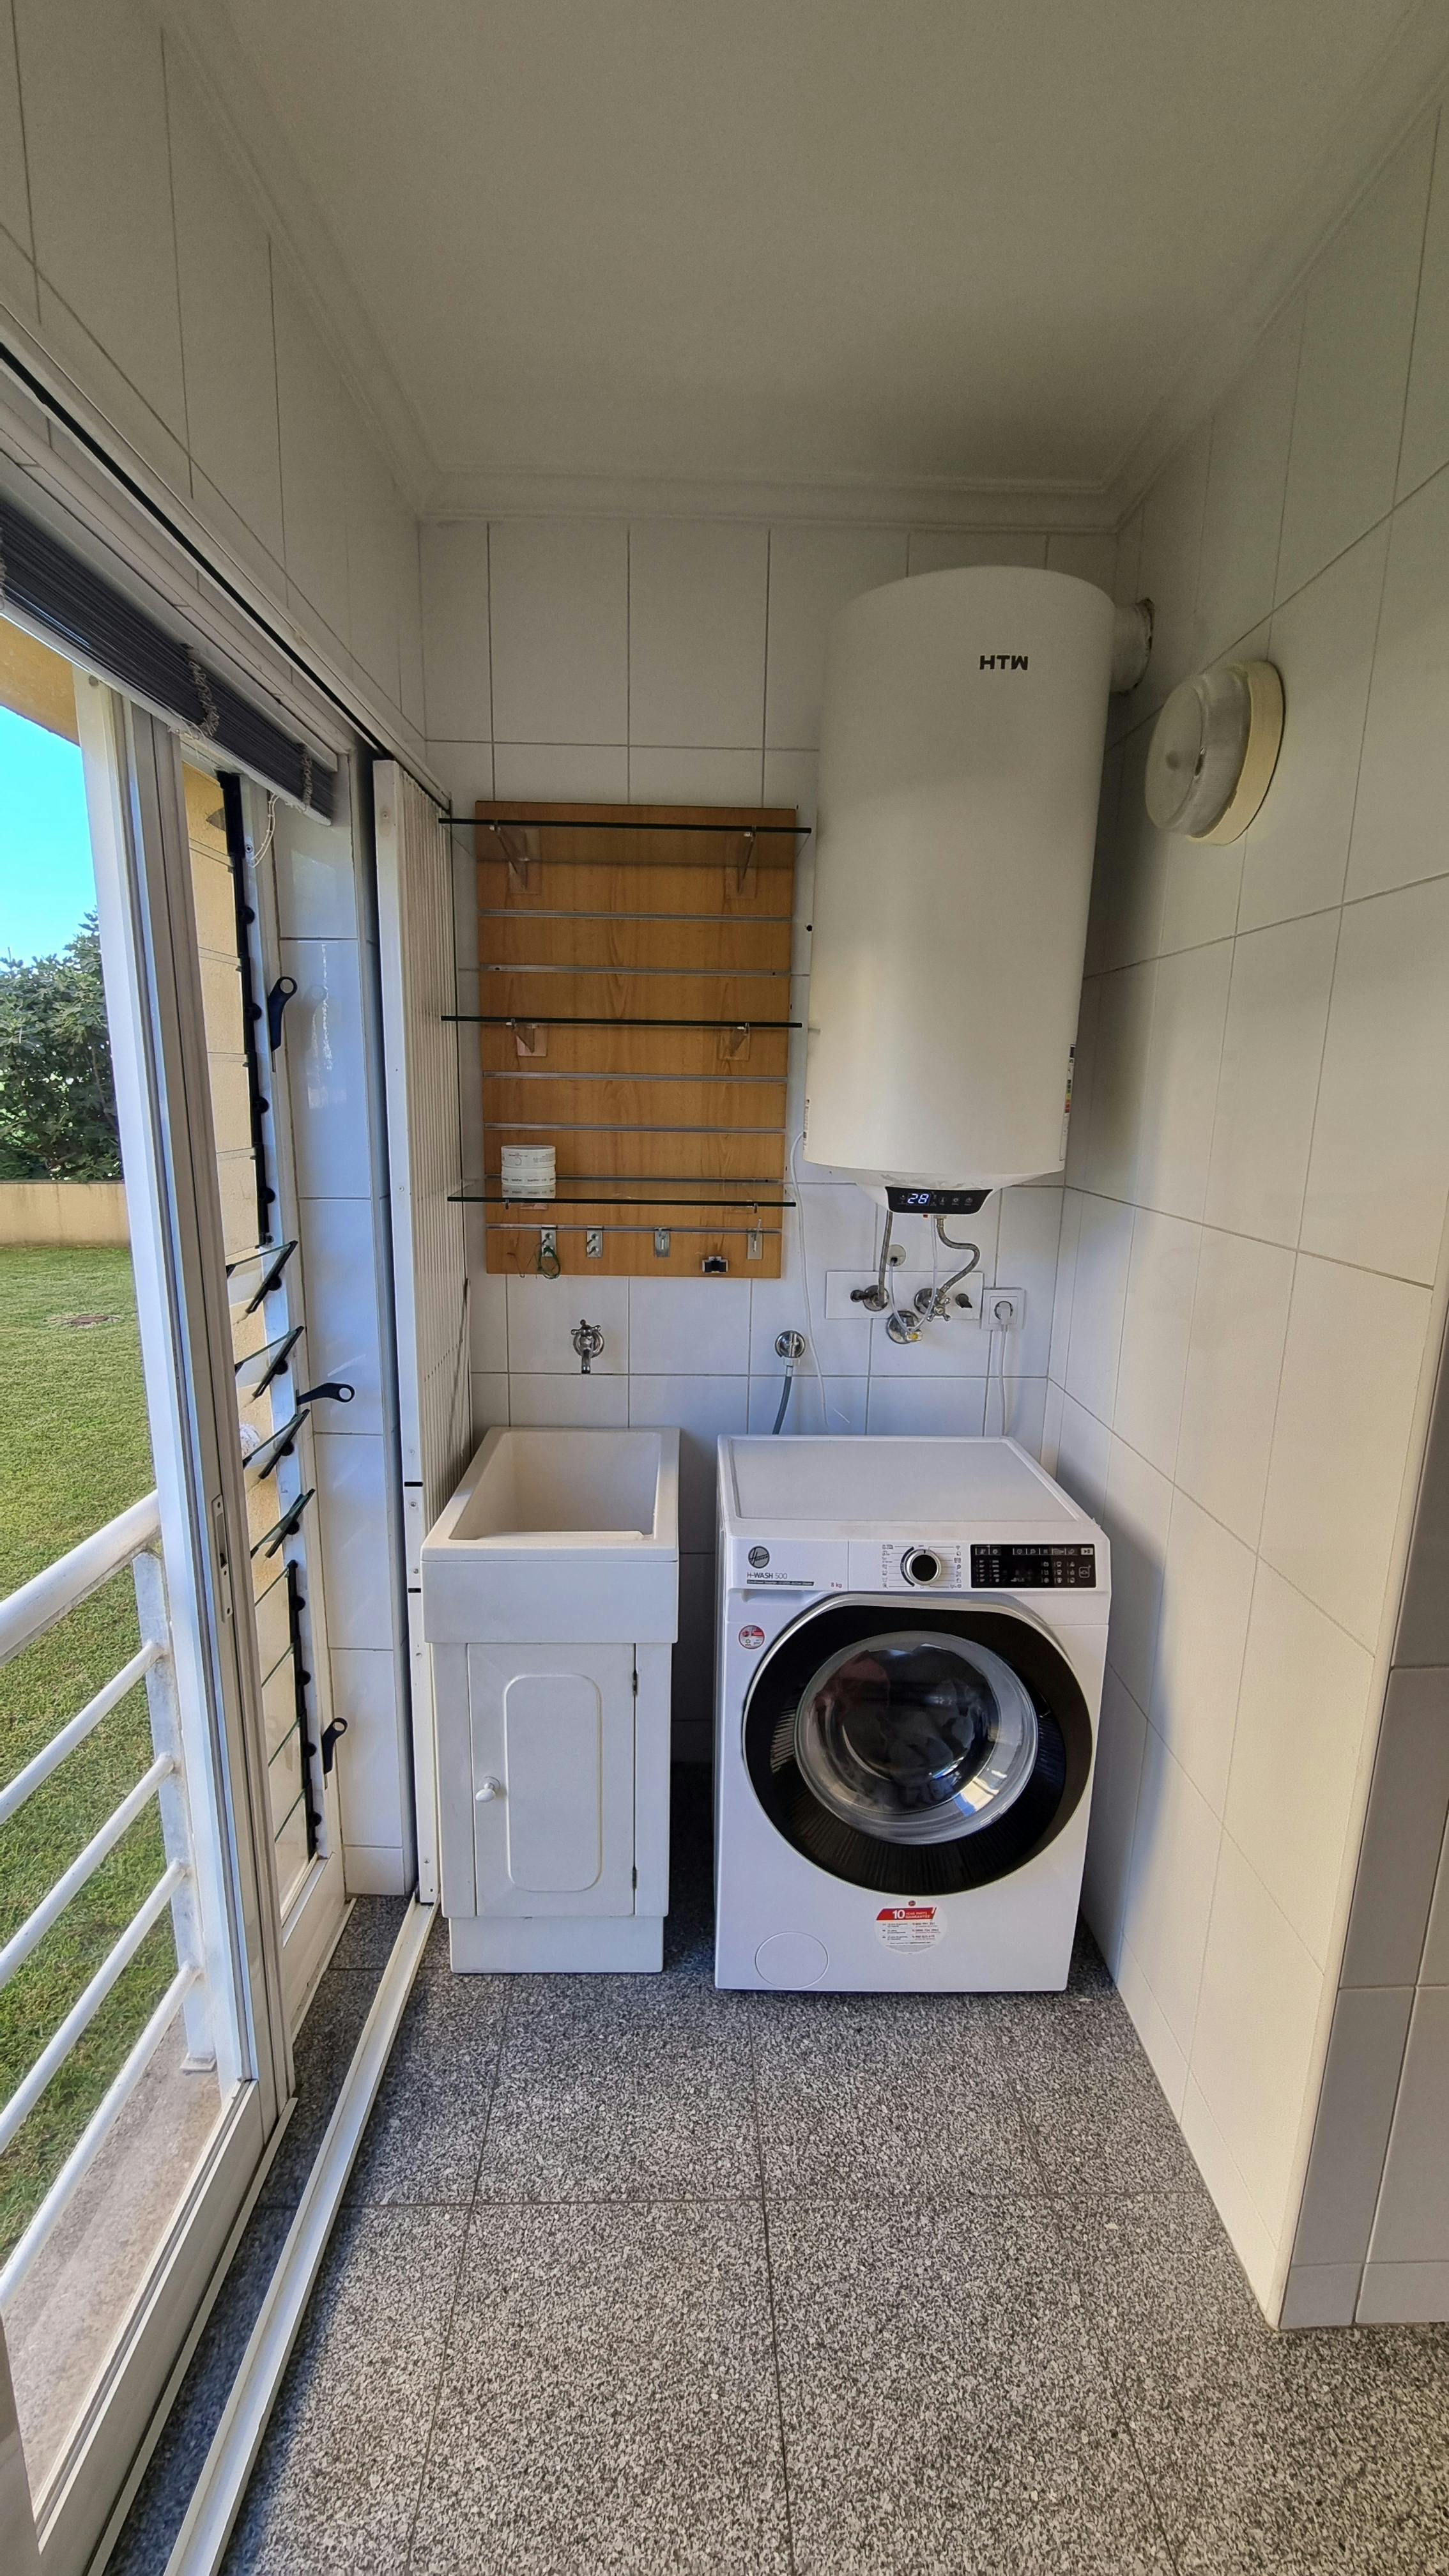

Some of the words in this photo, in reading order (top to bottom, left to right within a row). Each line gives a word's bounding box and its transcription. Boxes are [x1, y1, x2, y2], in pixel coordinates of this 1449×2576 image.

[979, 655, 1029, 670] HTW
[907, 1193, 930, 1204] 28
[893, 1909, 905, 1919] 10
